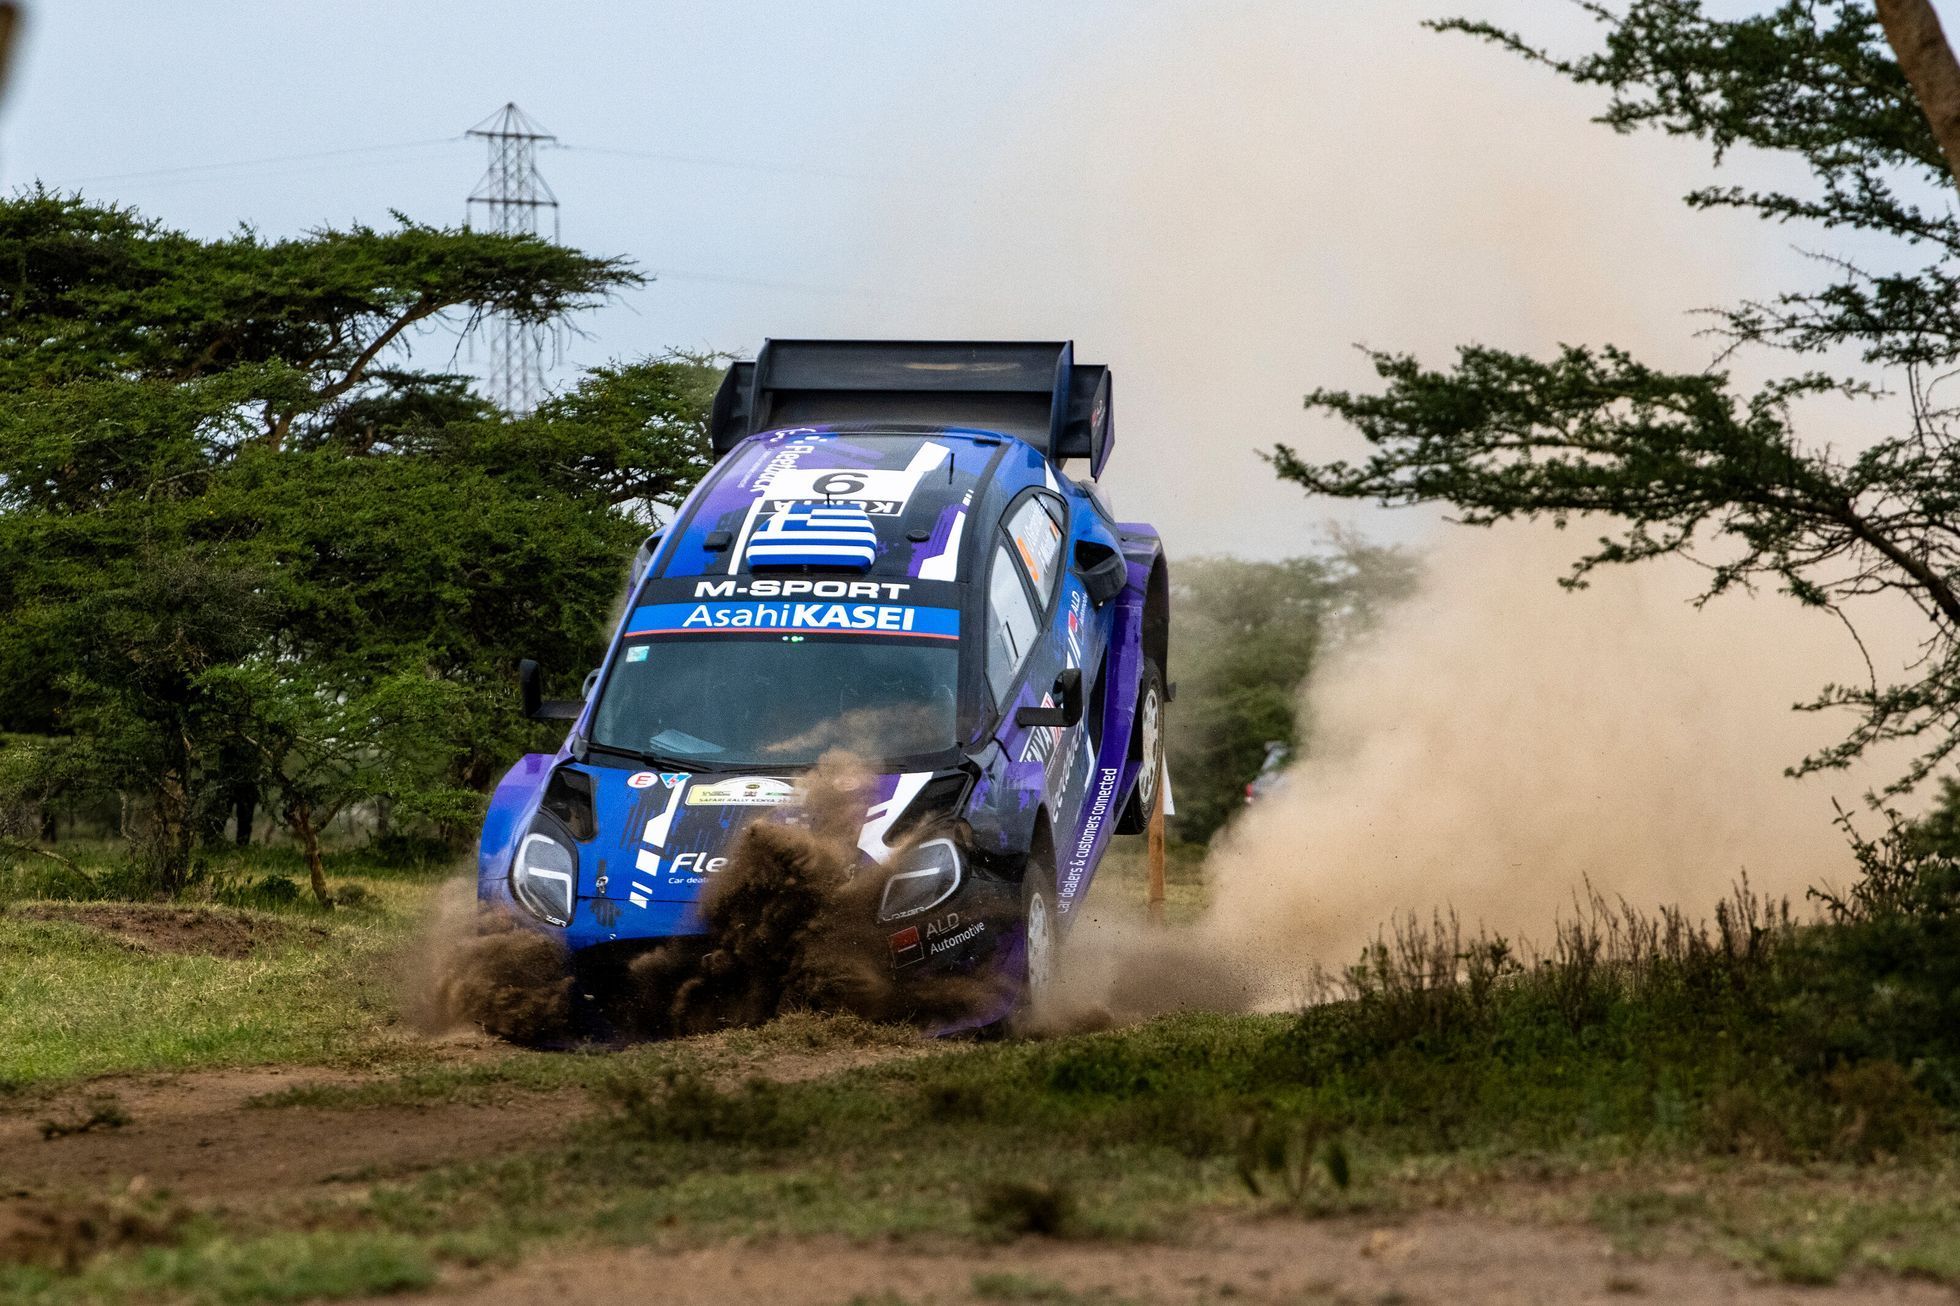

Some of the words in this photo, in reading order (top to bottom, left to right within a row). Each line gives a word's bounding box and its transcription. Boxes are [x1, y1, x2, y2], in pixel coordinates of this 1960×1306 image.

[694, 580, 910, 600] M-SPORT
[635, 775, 651, 786] E
[1093, 768, 1118, 816] connected
[1077, 815, 1101, 859] customers
[1071, 857, 1085, 868] &
[1058, 867, 1083, 898] dealers
[926, 912, 960, 940] ALD
[930, 922, 985, 955] Automotive
